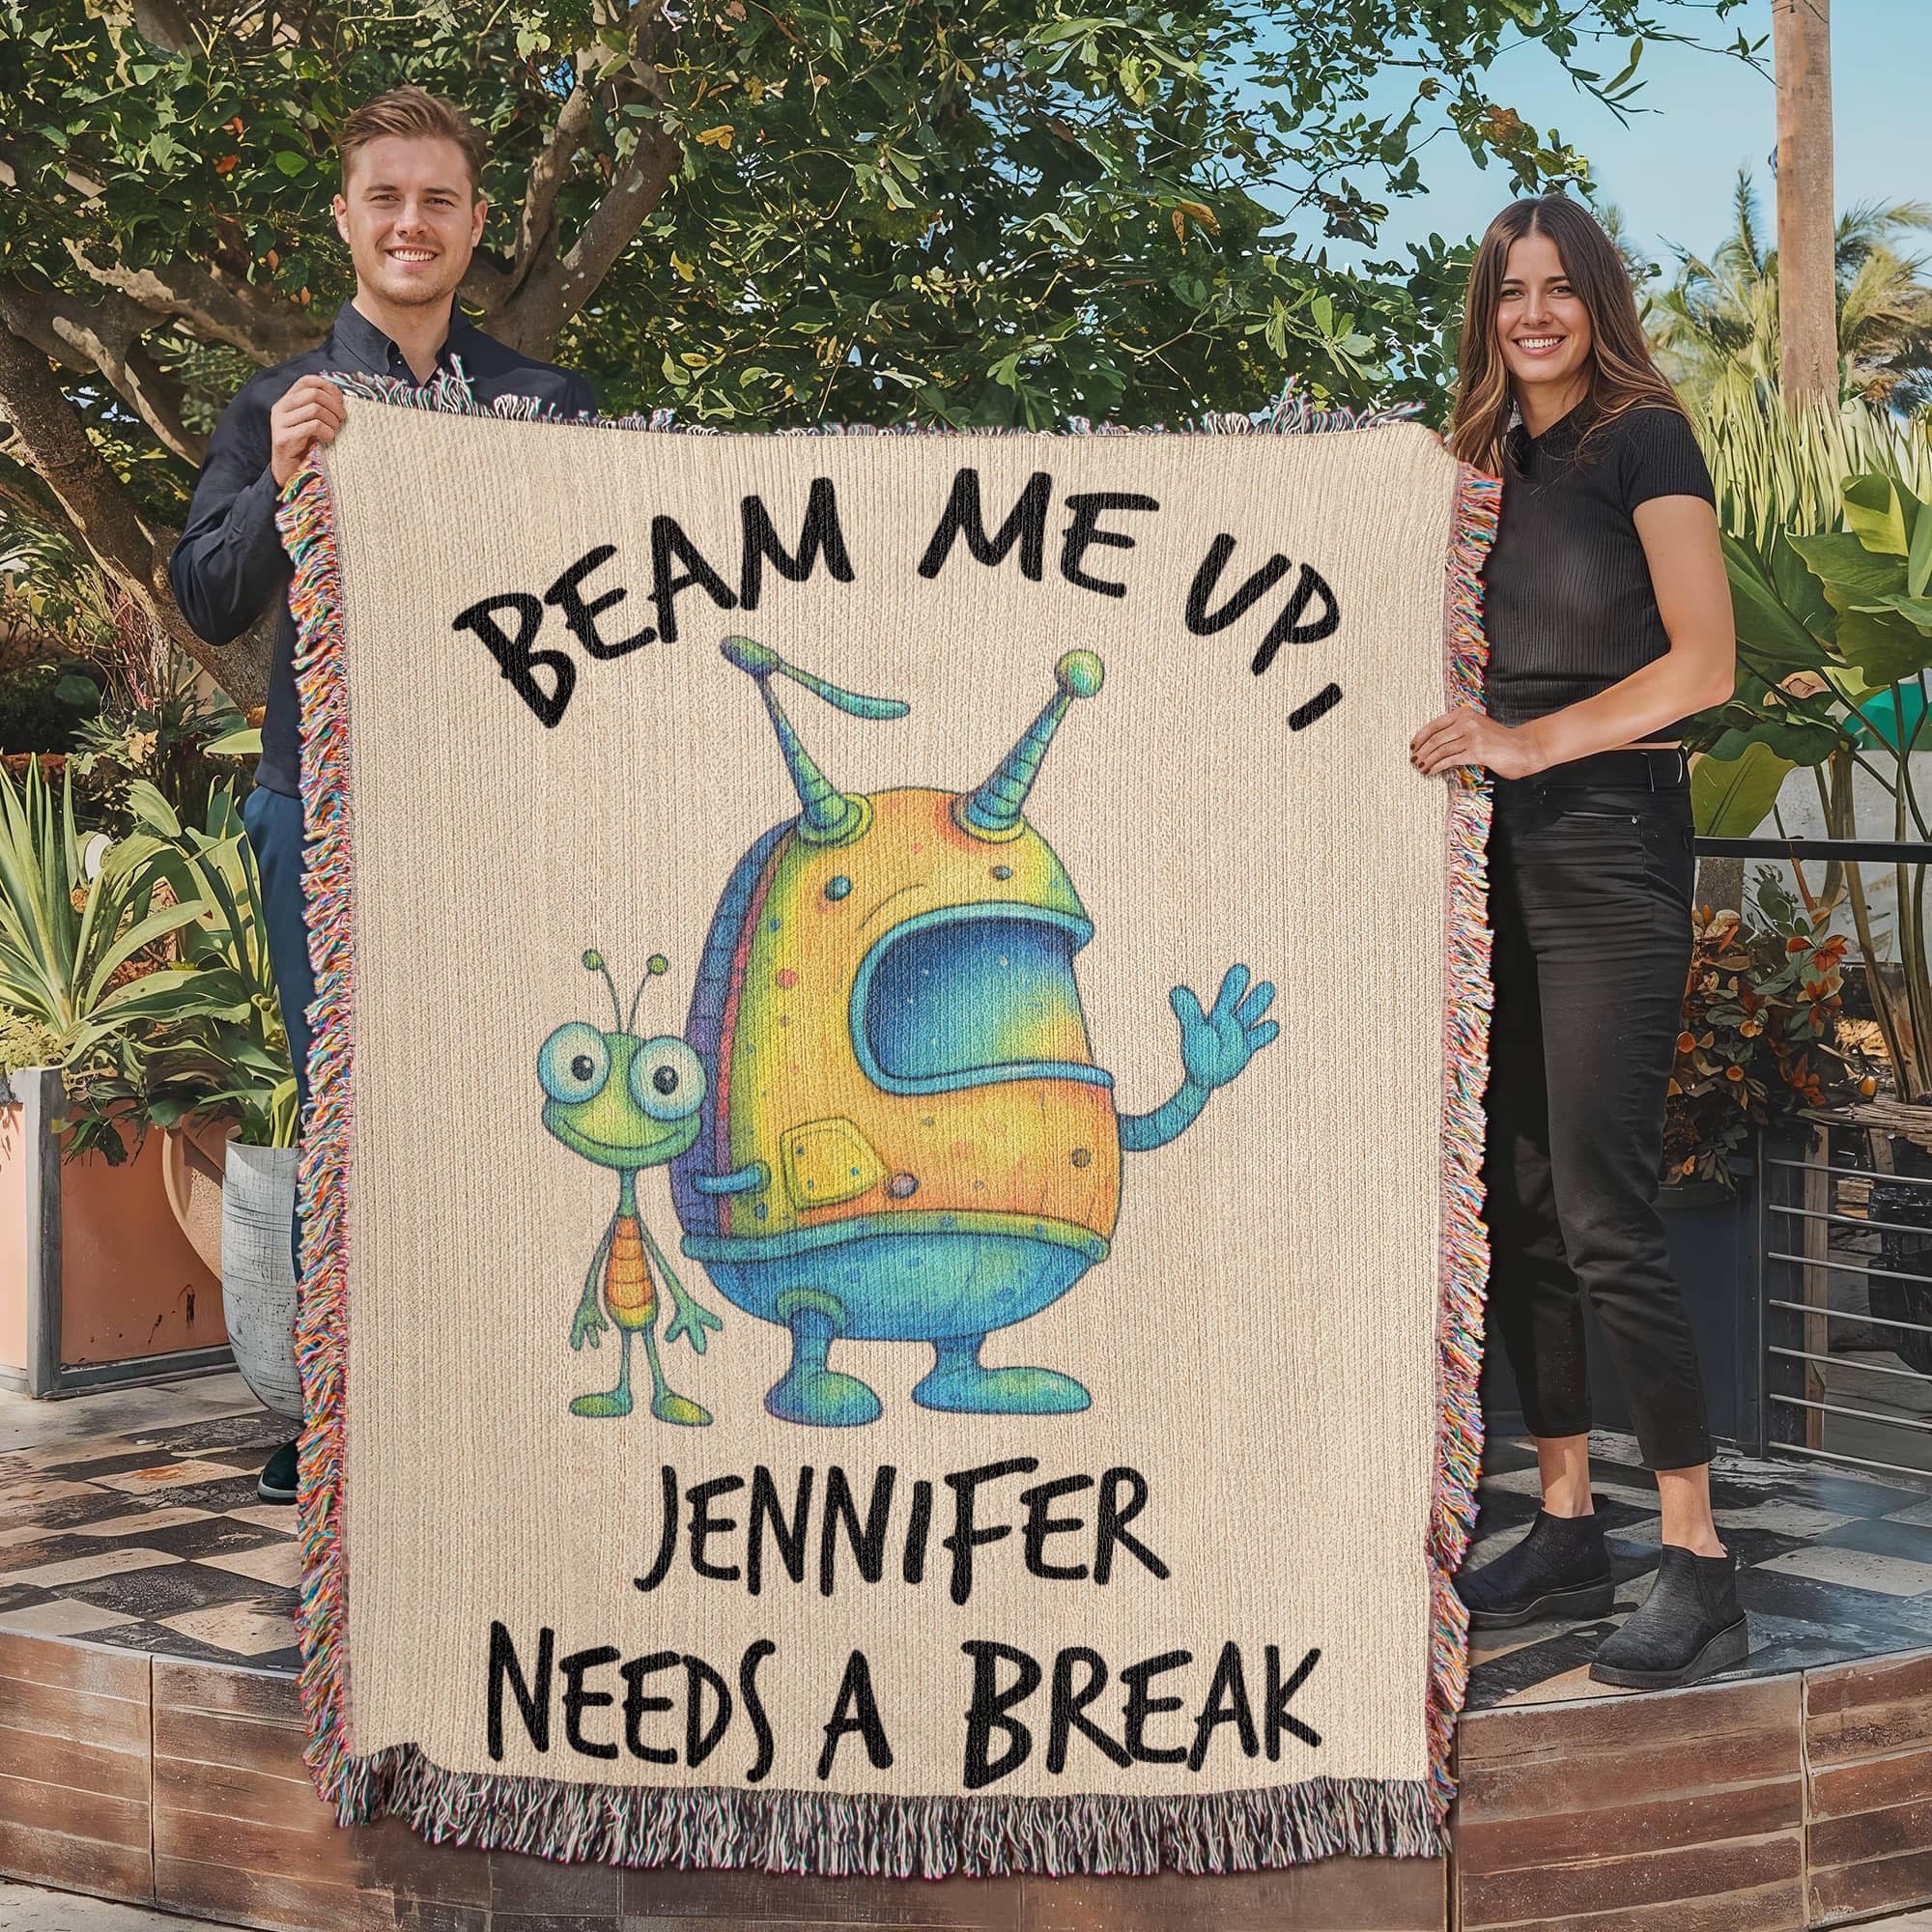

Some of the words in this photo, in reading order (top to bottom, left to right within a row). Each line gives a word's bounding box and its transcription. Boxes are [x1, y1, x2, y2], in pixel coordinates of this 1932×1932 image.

[452, 477, 855, 728] BEAM
[918, 469, 1159, 598] ME
[1185, 533, 1343, 731] UP,
[633, 1456, 1170, 1605] JENNIFER
[487, 1621, 776, 1784] NEEDS
[816, 1649, 894, 1780] A
[960, 1639, 1322, 1789] BREAK
